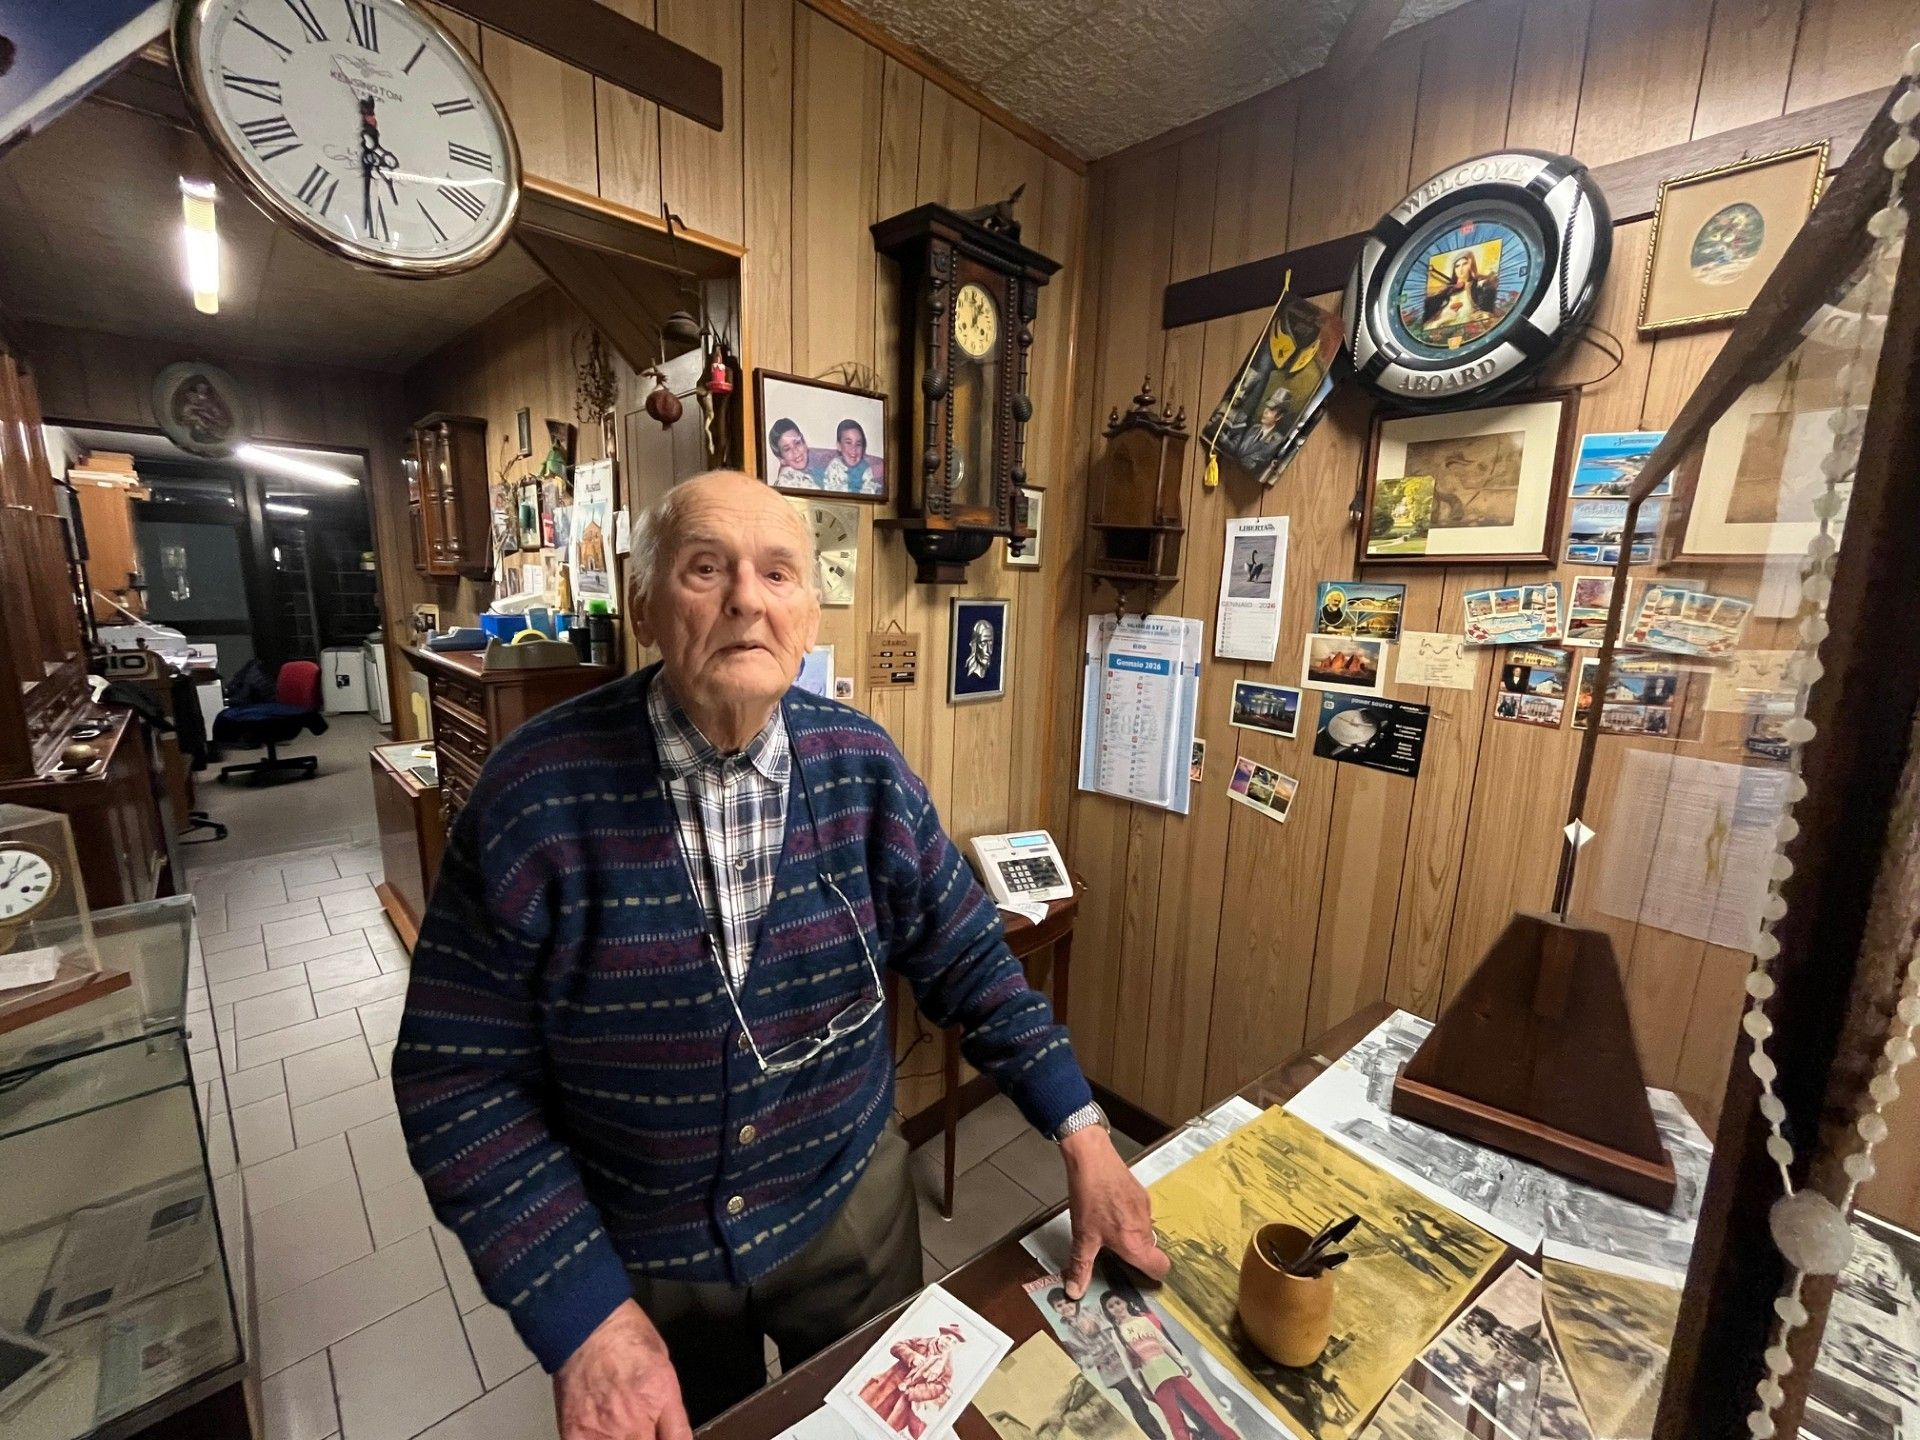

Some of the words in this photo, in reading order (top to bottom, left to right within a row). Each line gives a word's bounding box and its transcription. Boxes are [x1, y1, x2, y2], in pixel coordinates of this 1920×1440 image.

[1401, 161, 1529, 214] WELCOME
[1398, 359, 1496, 391] ABOARD
[1221, 601, 1253, 609] GENNAIO
[1116, 659, 1144, 669] Gennaio
[1145, 661, 1162, 671] 2026
[1351, 698, 1371, 706] power
[1371, 701, 1393, 710] source
